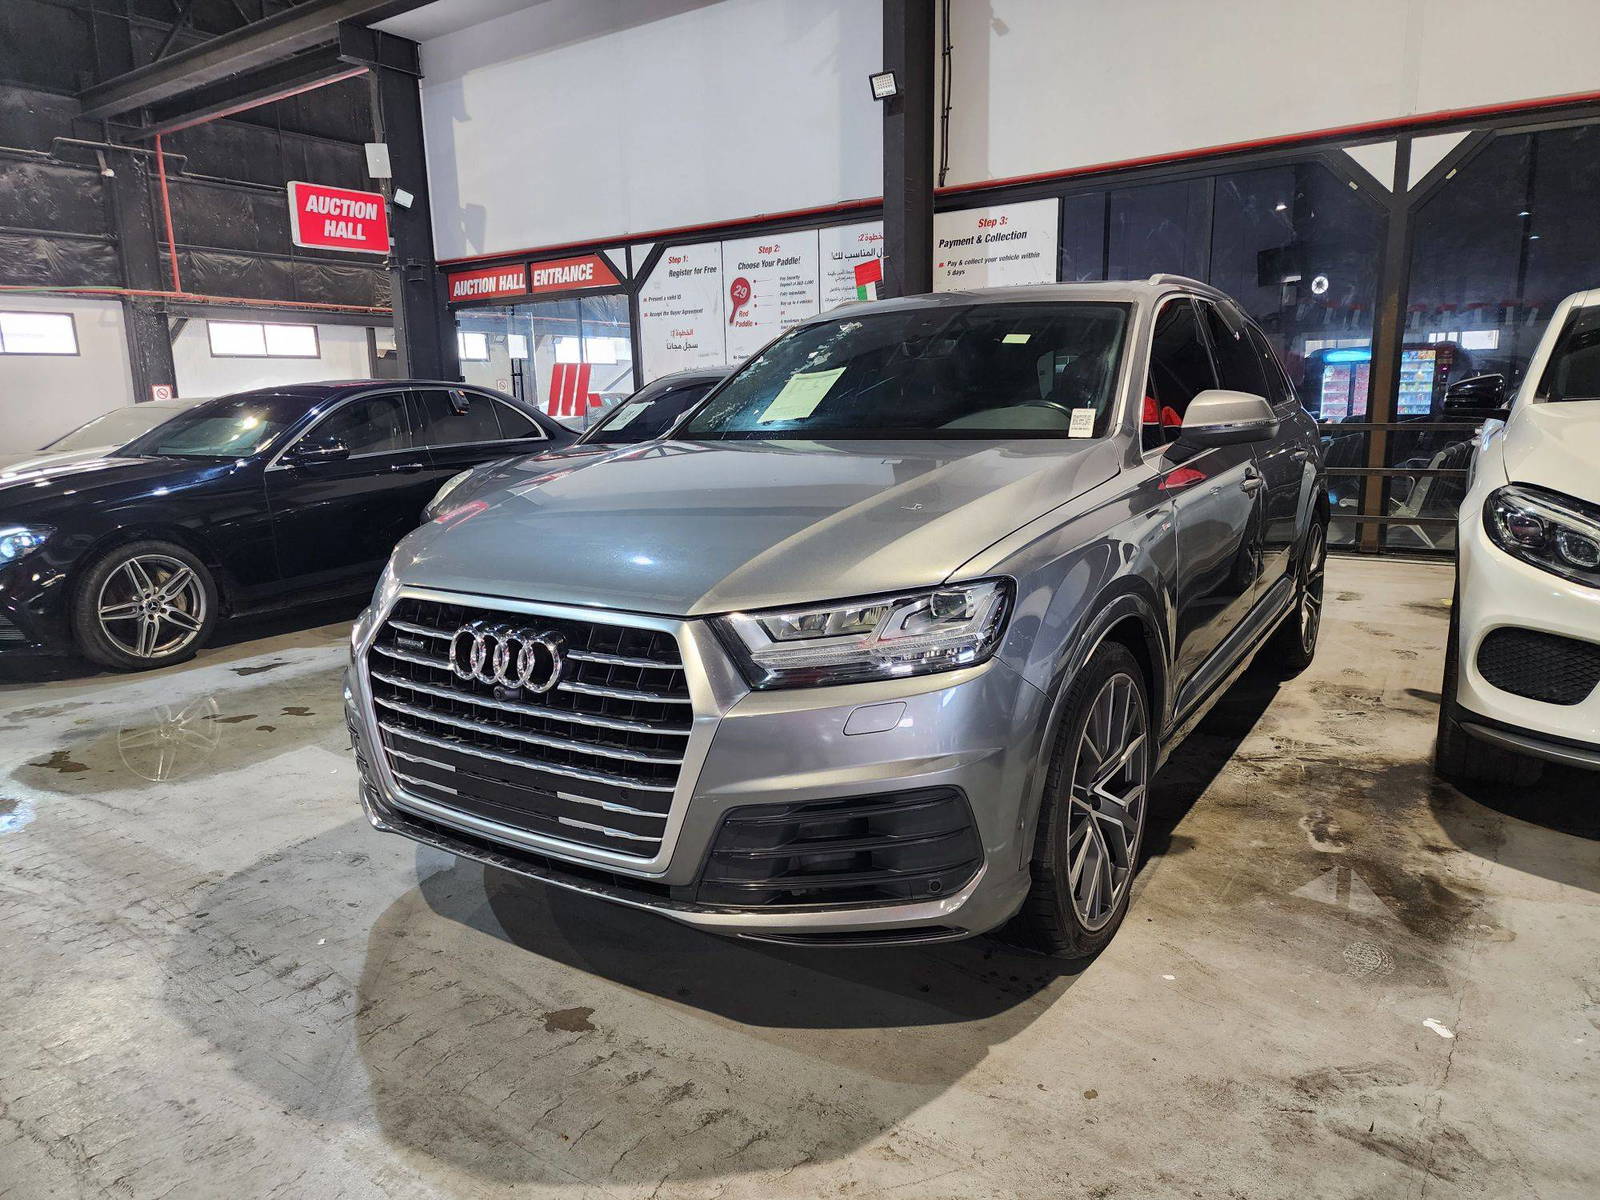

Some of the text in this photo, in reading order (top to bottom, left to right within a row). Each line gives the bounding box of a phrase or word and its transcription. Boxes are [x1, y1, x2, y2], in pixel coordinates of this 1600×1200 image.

[305, 194, 378, 221] AUCTION
[978, 216, 1009, 229] Step 3:
[324, 219, 366, 241] HALL
[938, 230, 1028, 249] Payment & Collection
[758, 244, 781, 255] Step 2:
[668, 256, 682, 265] Step
[737, 256, 801, 270] Choose Your Paddle!
[946, 260, 958, 268] Pay
[964, 257, 984, 265] collect
[984, 256, 998, 264] your
[998, 254, 1020, 262] vehicle
[1020, 251, 1040, 260] within
[668, 265, 717, 278] Register for Free
[952, 268, 966, 277] days
[453, 263, 594, 297] AUCTION HALL ENTRANCE
[733, 284, 748, 299] 29
